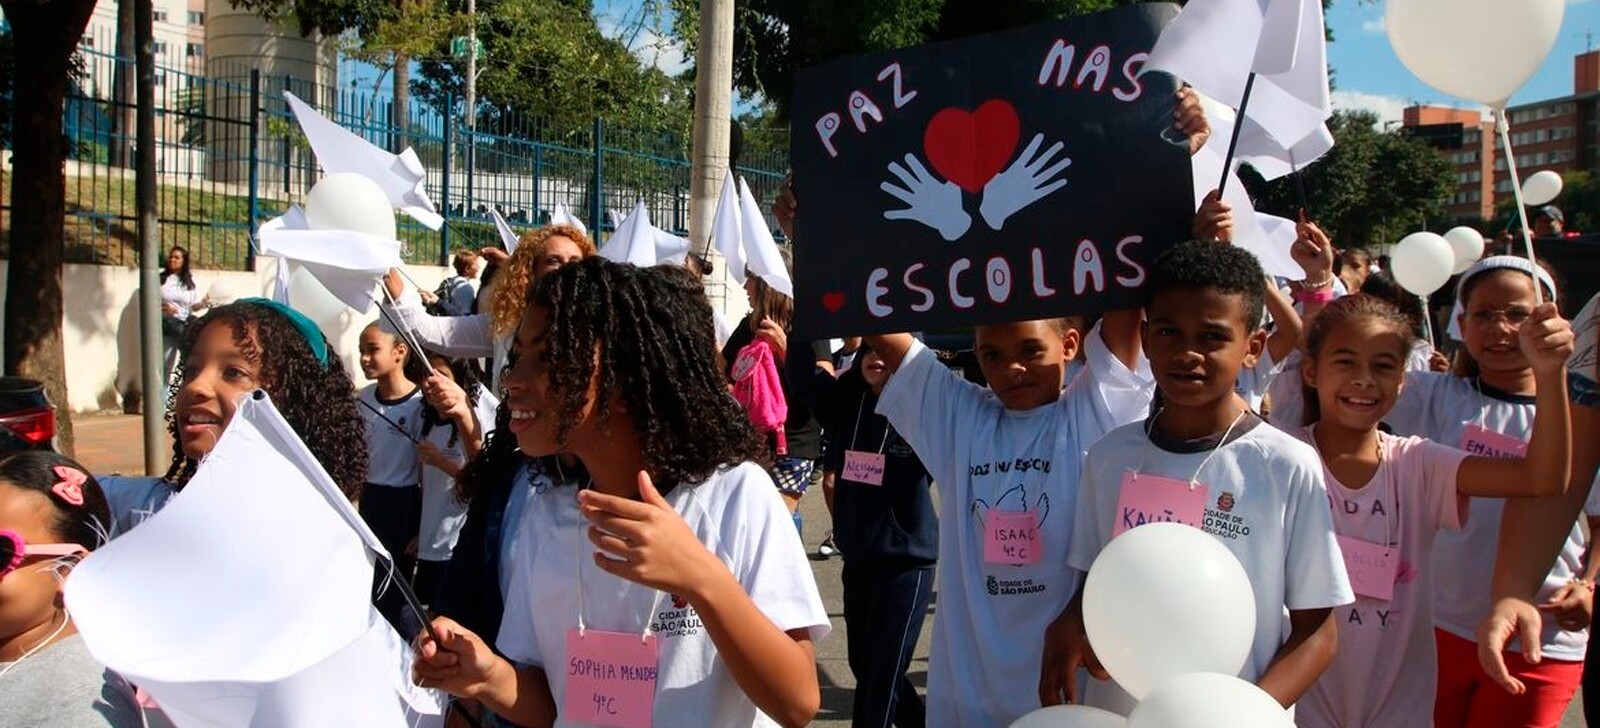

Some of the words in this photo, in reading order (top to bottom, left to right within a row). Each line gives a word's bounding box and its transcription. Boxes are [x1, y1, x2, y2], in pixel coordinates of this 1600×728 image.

[815, 62, 918, 158] PAZ
[1038, 38, 1150, 102] NAS
[864, 235, 1147, 318] ESCOLAS
[995, 529, 1035, 541] ISAAC
[1215, 519, 1250, 536] PAULO
[1017, 584, 1046, 595] PAULO
[569, 657, 616, 680] SOPHIA
